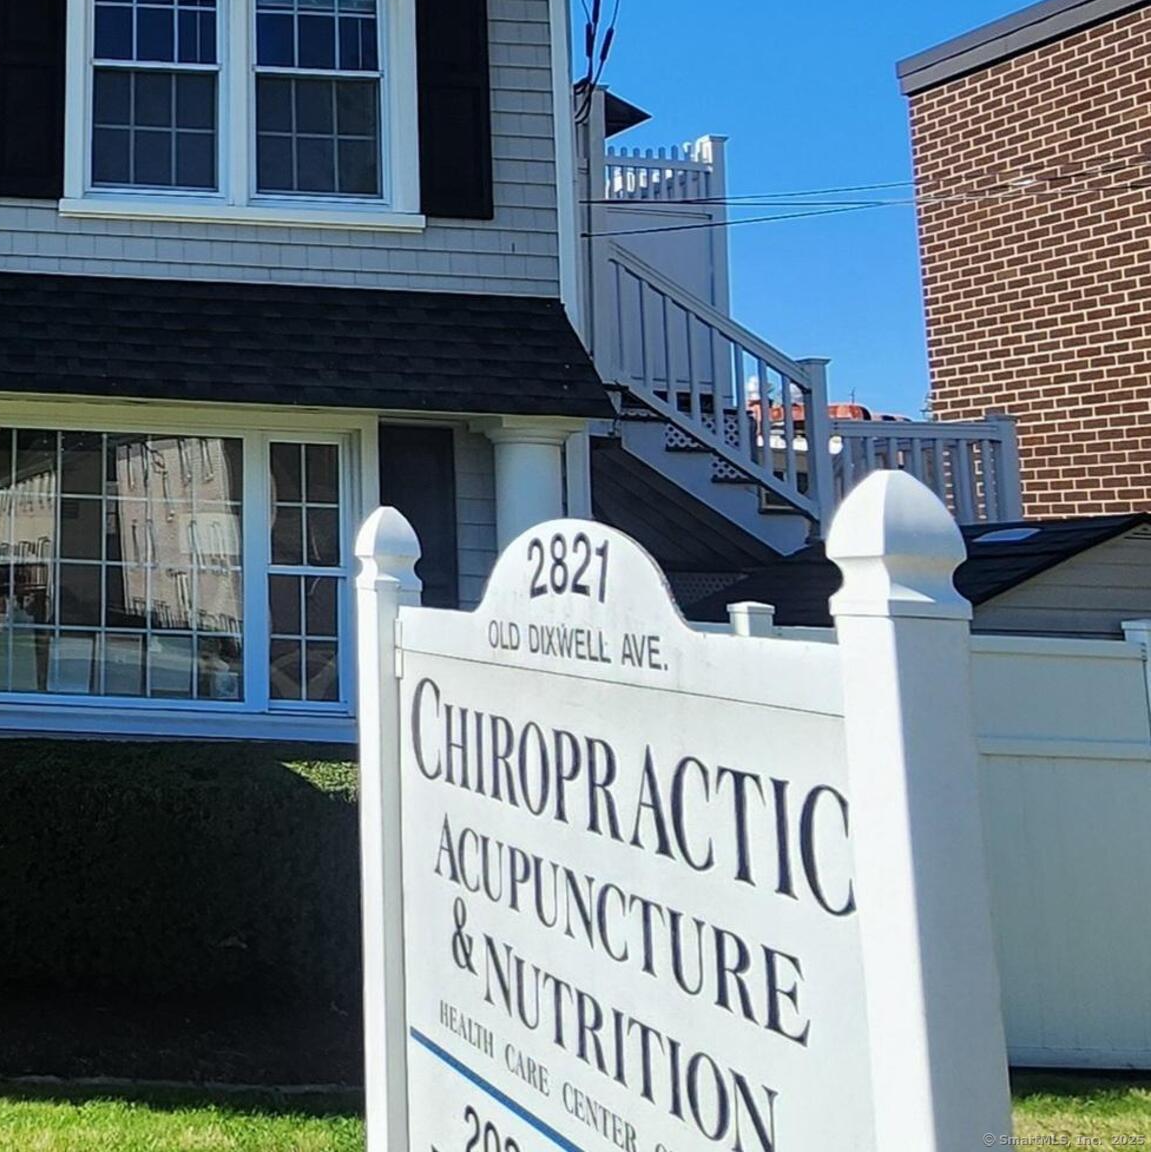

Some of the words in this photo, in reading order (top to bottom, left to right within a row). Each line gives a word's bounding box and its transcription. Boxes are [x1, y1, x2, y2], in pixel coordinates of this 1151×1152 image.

[527, 531, 609, 604] 2821
[488, 620, 520, 650] OLD
[529, 623, 612, 664] DIXWELL
[621, 634, 669, 671] AVE.
[411, 677, 856, 917] CHIROPRACTIC
[434, 812, 811, 1048] ACUPUNCTURE
[440, 999, 494, 1059] HEALTH
[504, 1043, 550, 1097] CARE
[562, 1081, 637, 1152] CENTER
